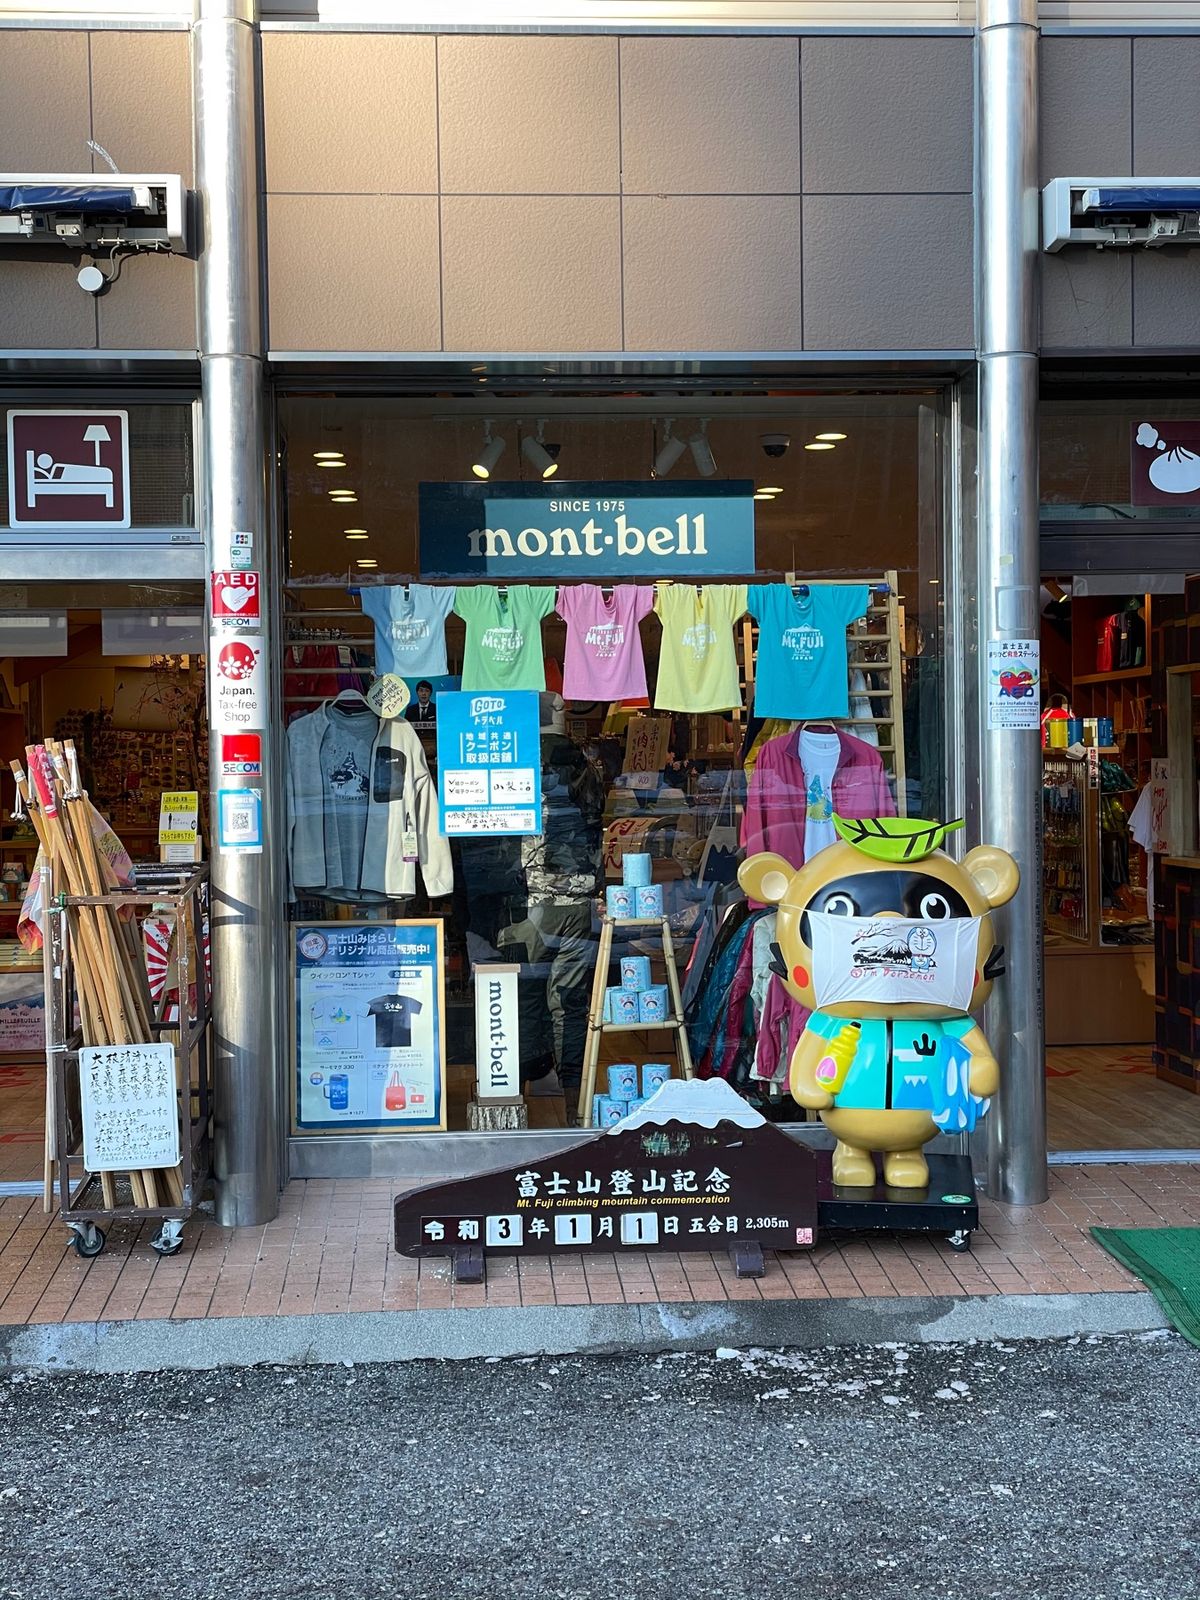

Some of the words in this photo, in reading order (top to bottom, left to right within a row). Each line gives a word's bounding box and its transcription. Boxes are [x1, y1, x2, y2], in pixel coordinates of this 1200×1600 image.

[549, 500, 590, 512] SINCE
[595, 500, 625, 512] 1975
[214, 573, 257, 586] AED
[221, 618, 250, 626] SECOM
[219, 686, 256, 698] Japan.
[999, 687, 1035, 697] AED
[218, 699, 258, 710] Tax-free
[224, 711, 251, 723] Shop
[474, 715, 503, 726] トラベル
[466, 741, 512, 752] クーポン
[466, 752, 512, 764] 取扱店舗
[223, 763, 260, 773] SECOM
[327, 933, 397, 945] 富士山みはらし
[514, 1166, 732, 1198] 富士山登山記念
[516, 1198, 532, 1209] Mt.
[534, 1198, 554, 1210] Fuji
[556, 1197, 599, 1209] climbing
[601, 1196, 648, 1206] mountain
[650, 1194, 731, 1206] commemoration
[745, 1217, 790, 1230] 2,305m
